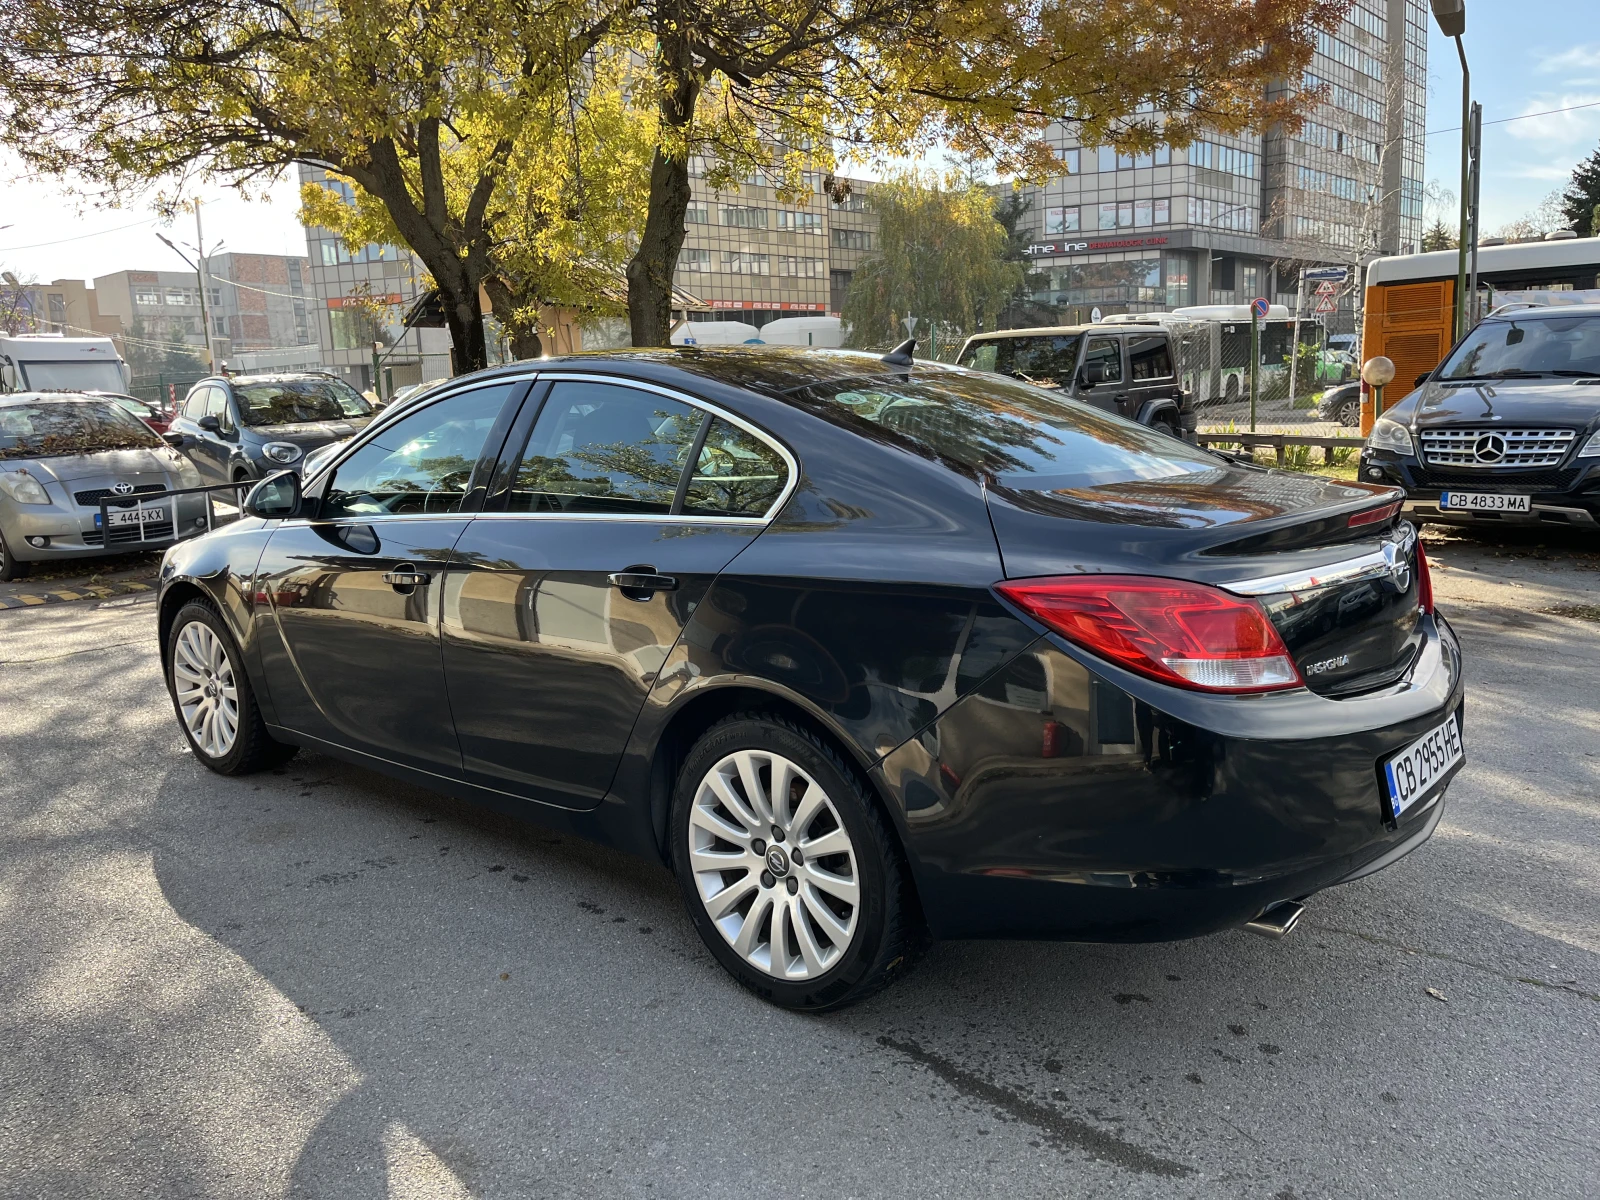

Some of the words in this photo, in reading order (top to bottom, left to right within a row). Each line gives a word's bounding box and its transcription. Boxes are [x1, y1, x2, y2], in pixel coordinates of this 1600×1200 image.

[1089, 237, 1144, 250] DERMATOLOGIC
[1145, 236, 1168, 246] CLINIC
[1450, 494, 1468, 507] CB
[1470, 495, 1504, 509] 4833
[1507, 497, 1526, 510] MA
[148, 509, 162, 521] KX
[1395, 755, 1417, 802] CB
[1414, 730, 1445, 788] 2955
[1441, 717, 1460, 762] HE
